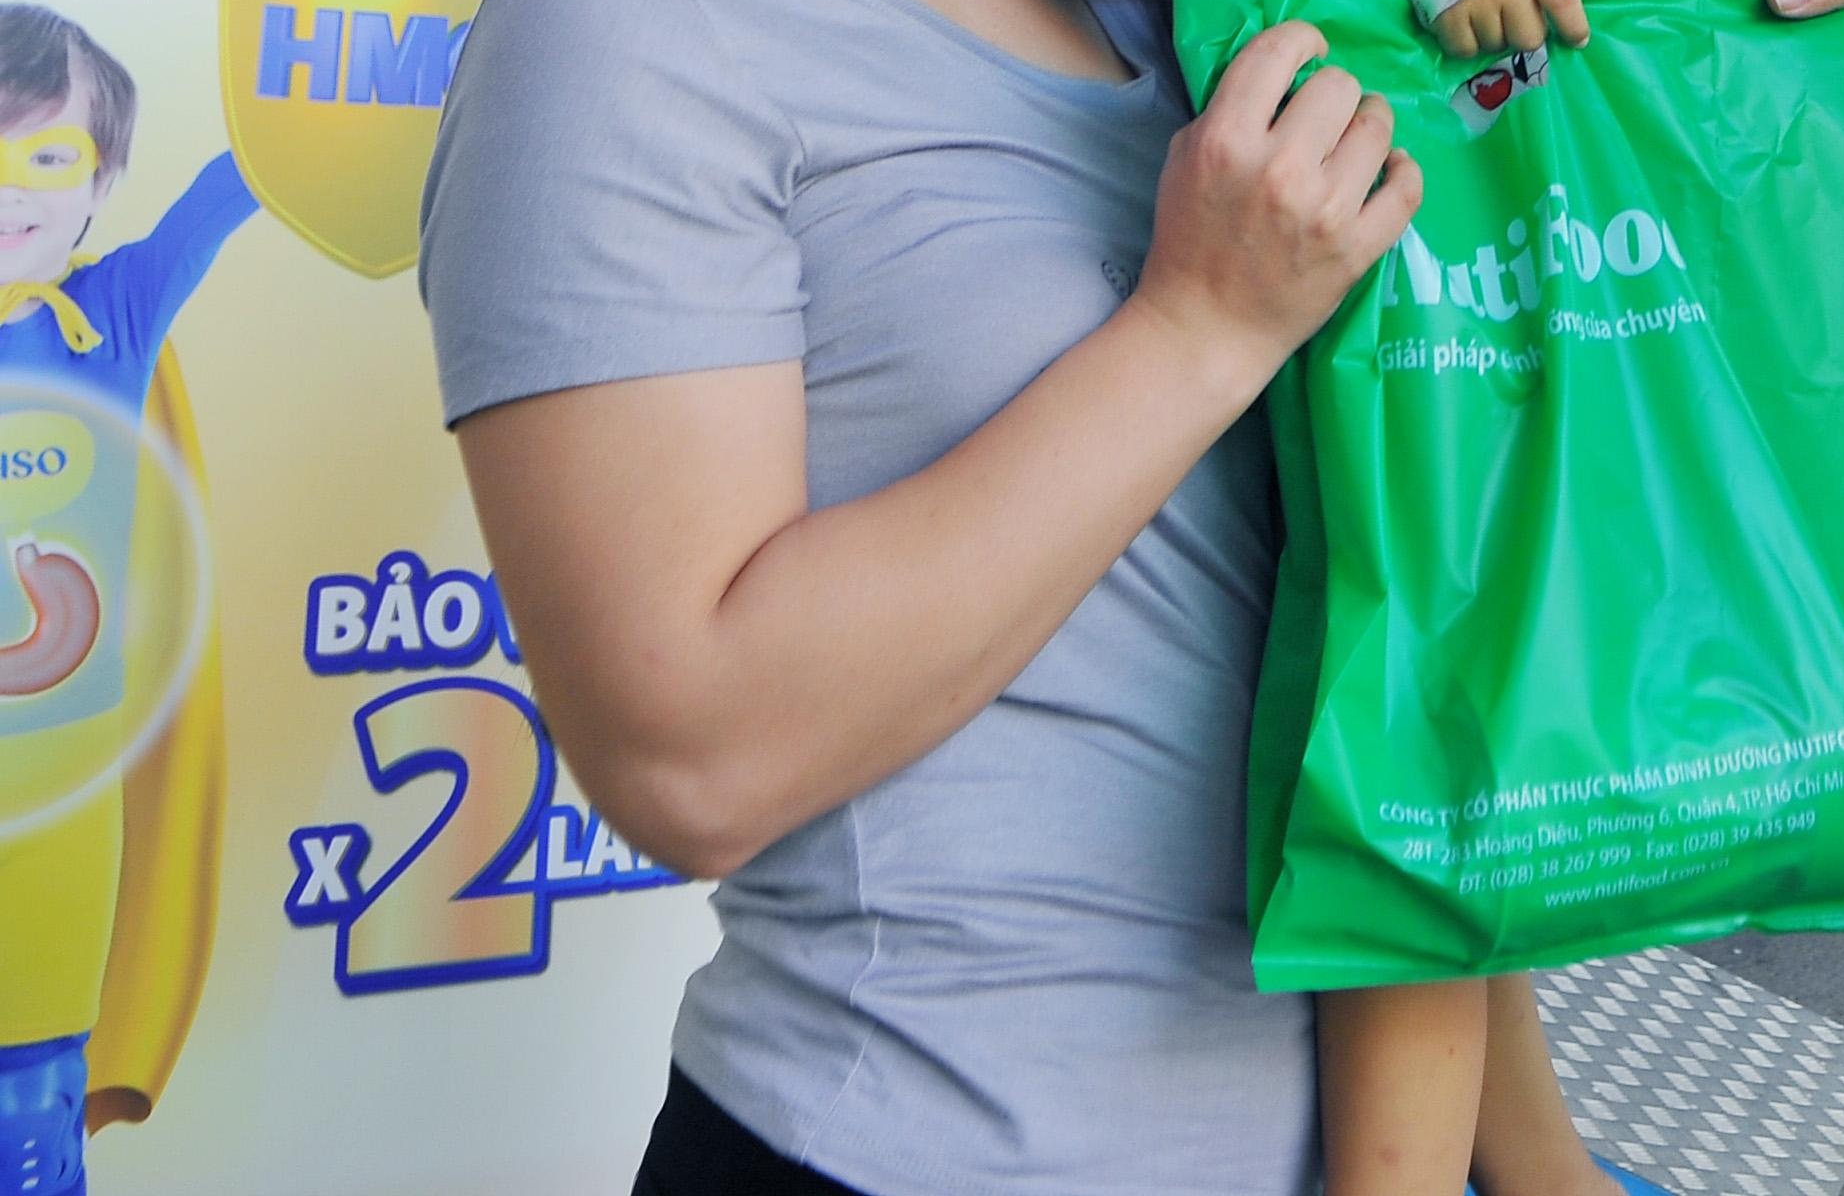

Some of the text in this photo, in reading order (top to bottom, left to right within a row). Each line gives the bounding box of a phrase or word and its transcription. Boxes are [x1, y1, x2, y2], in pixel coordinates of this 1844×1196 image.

[1434, 336, 1496, 376] pháp
[1616, 295, 1706, 339] chuyên
[310, 555, 489, 664] BẢO
[339, 678, 556, 993] 2
[1379, 800, 1433, 826] CÔNG
[1438, 806, 1459, 827] TY
[1490, 864, 1535, 891] (028)
[1564, 851, 1595, 876] 267
[1599, 843, 1632, 869] 999
[1682, 828, 1726, 855] (028)
[1730, 825, 1751, 846] 39
[1754, 818, 1783, 841] 435
